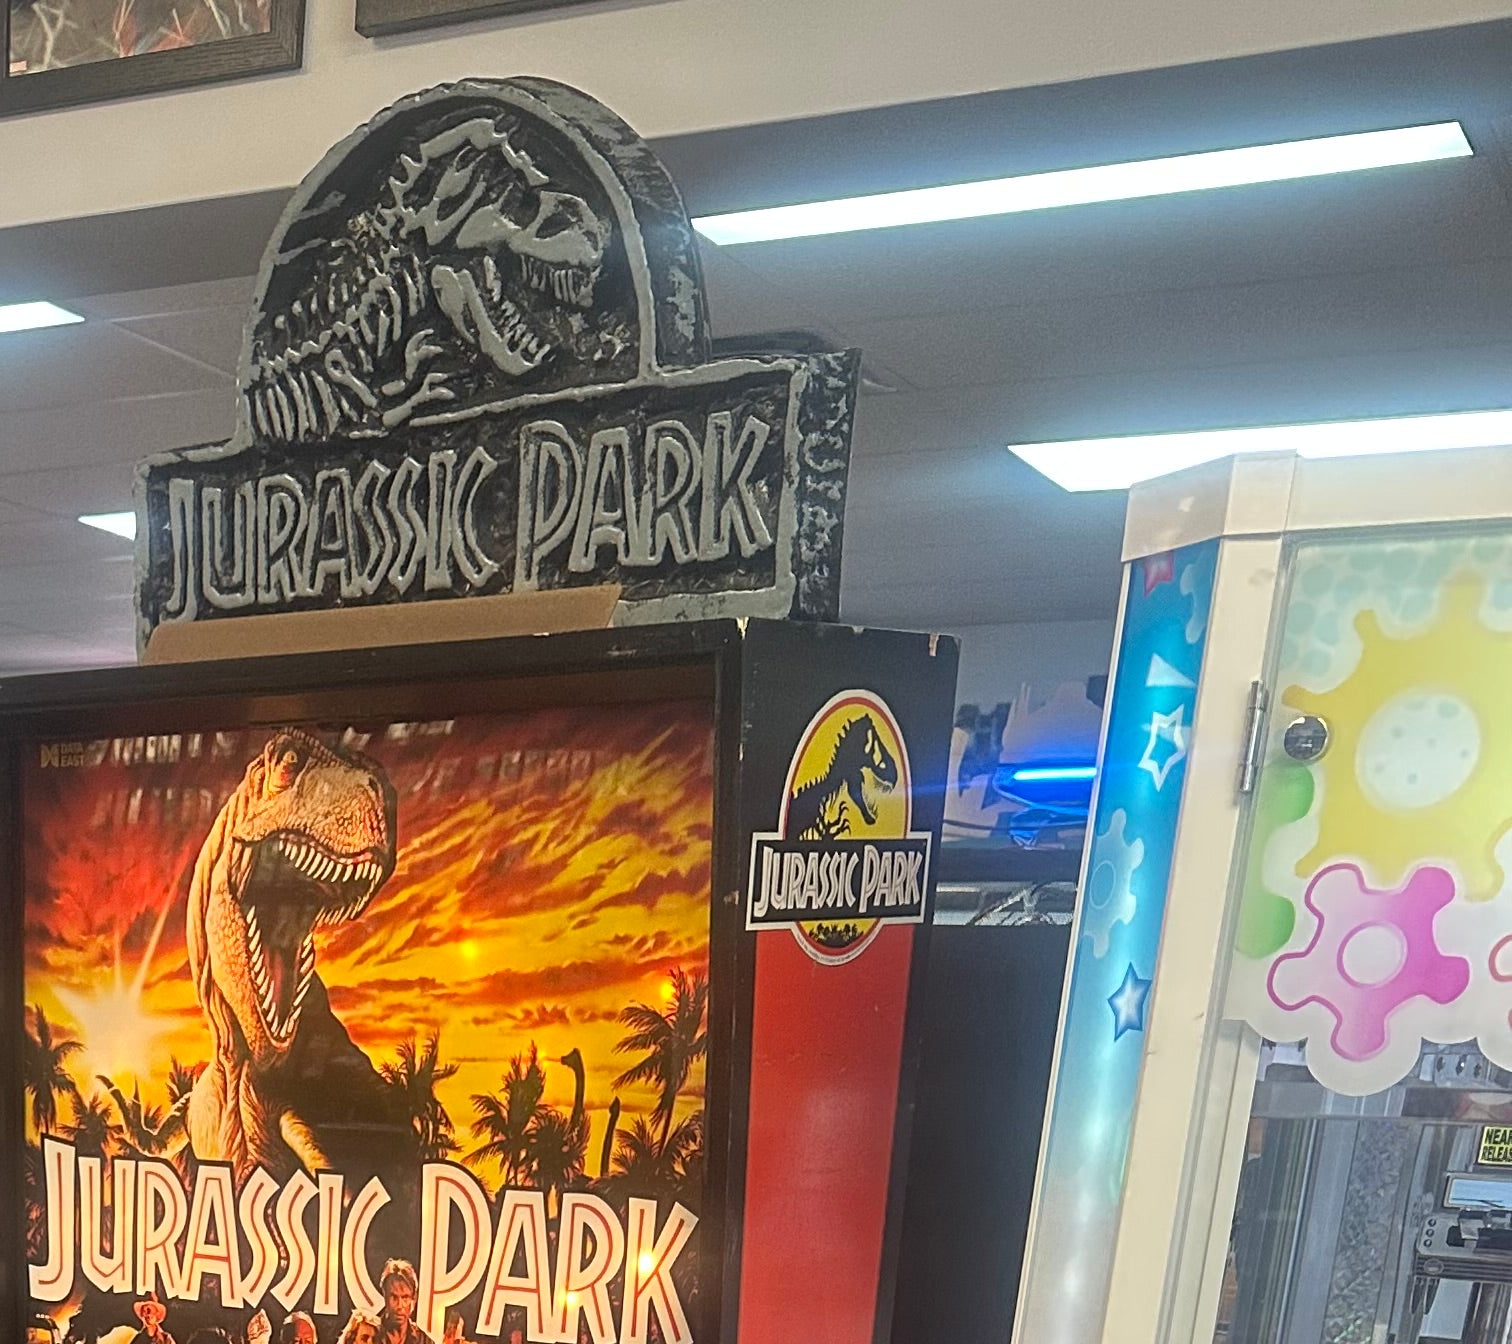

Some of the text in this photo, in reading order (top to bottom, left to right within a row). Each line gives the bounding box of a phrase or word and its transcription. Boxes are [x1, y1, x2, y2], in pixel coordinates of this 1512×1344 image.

[159, 410, 772, 623] JURASSIC PARK
[753, 844, 924, 918] JURASSIC PARK
[28, 1137, 391, 1317] JURASSIC
